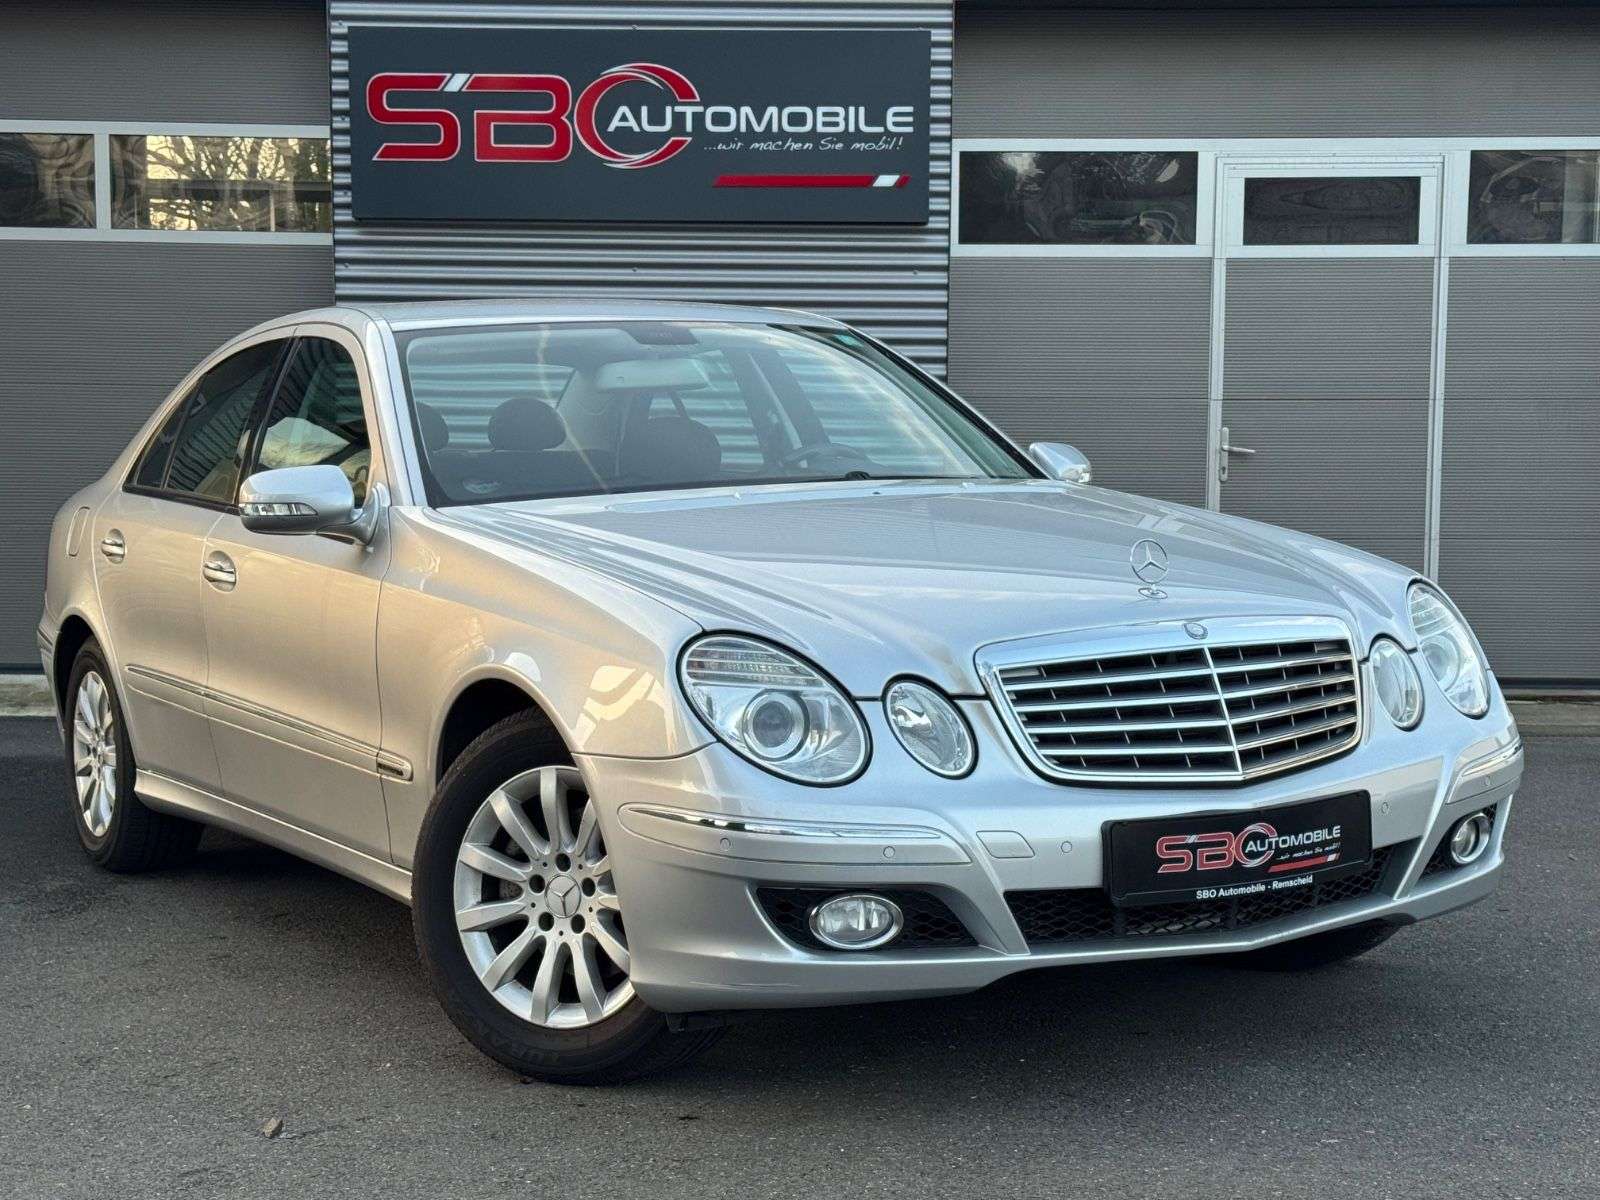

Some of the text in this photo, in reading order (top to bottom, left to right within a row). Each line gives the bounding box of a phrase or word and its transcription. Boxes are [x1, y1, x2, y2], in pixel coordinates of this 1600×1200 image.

[606, 105, 915, 133] AUTOMOBILE
[750, 137, 814, 151] machen
[819, 137, 844, 150] Sie
[851, 136, 903, 151] mobil!
[1244, 825, 1342, 853] AUTOMOBILE
[1196, 889, 1217, 899] SBO
[1218, 883, 1266, 897] Automobile
[1272, 875, 1314, 890] Remscheid
